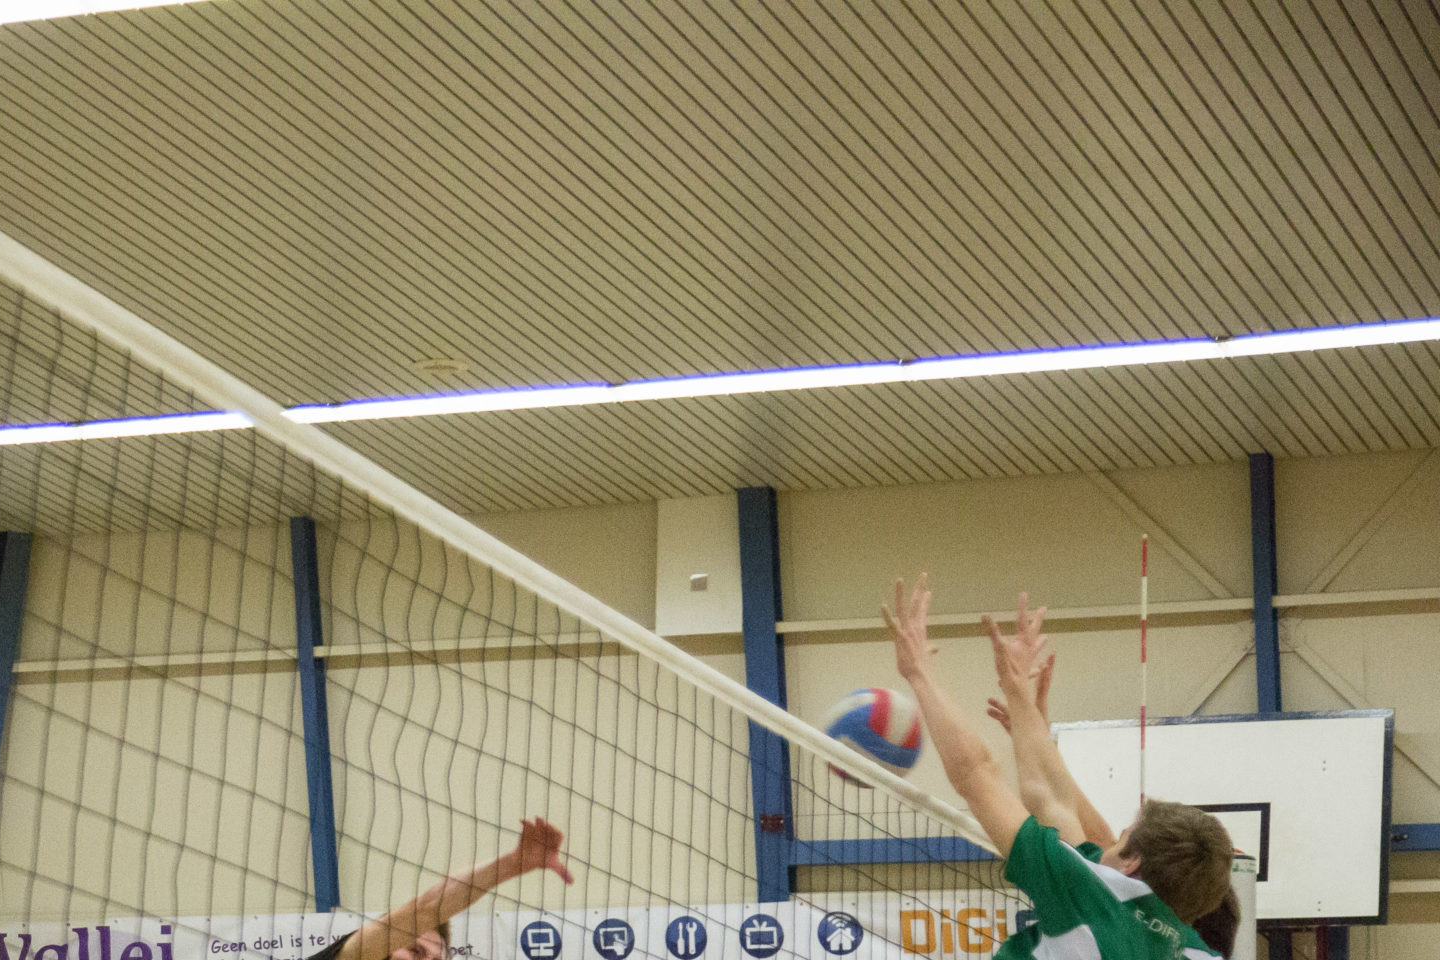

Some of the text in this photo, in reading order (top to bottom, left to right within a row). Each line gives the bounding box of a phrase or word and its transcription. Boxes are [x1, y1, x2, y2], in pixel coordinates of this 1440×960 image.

[211, 940, 247, 954] Geen
[254, 935, 283, 950] doel
[291, 935, 303, 947] is
[309, 934, 325, 946] te
